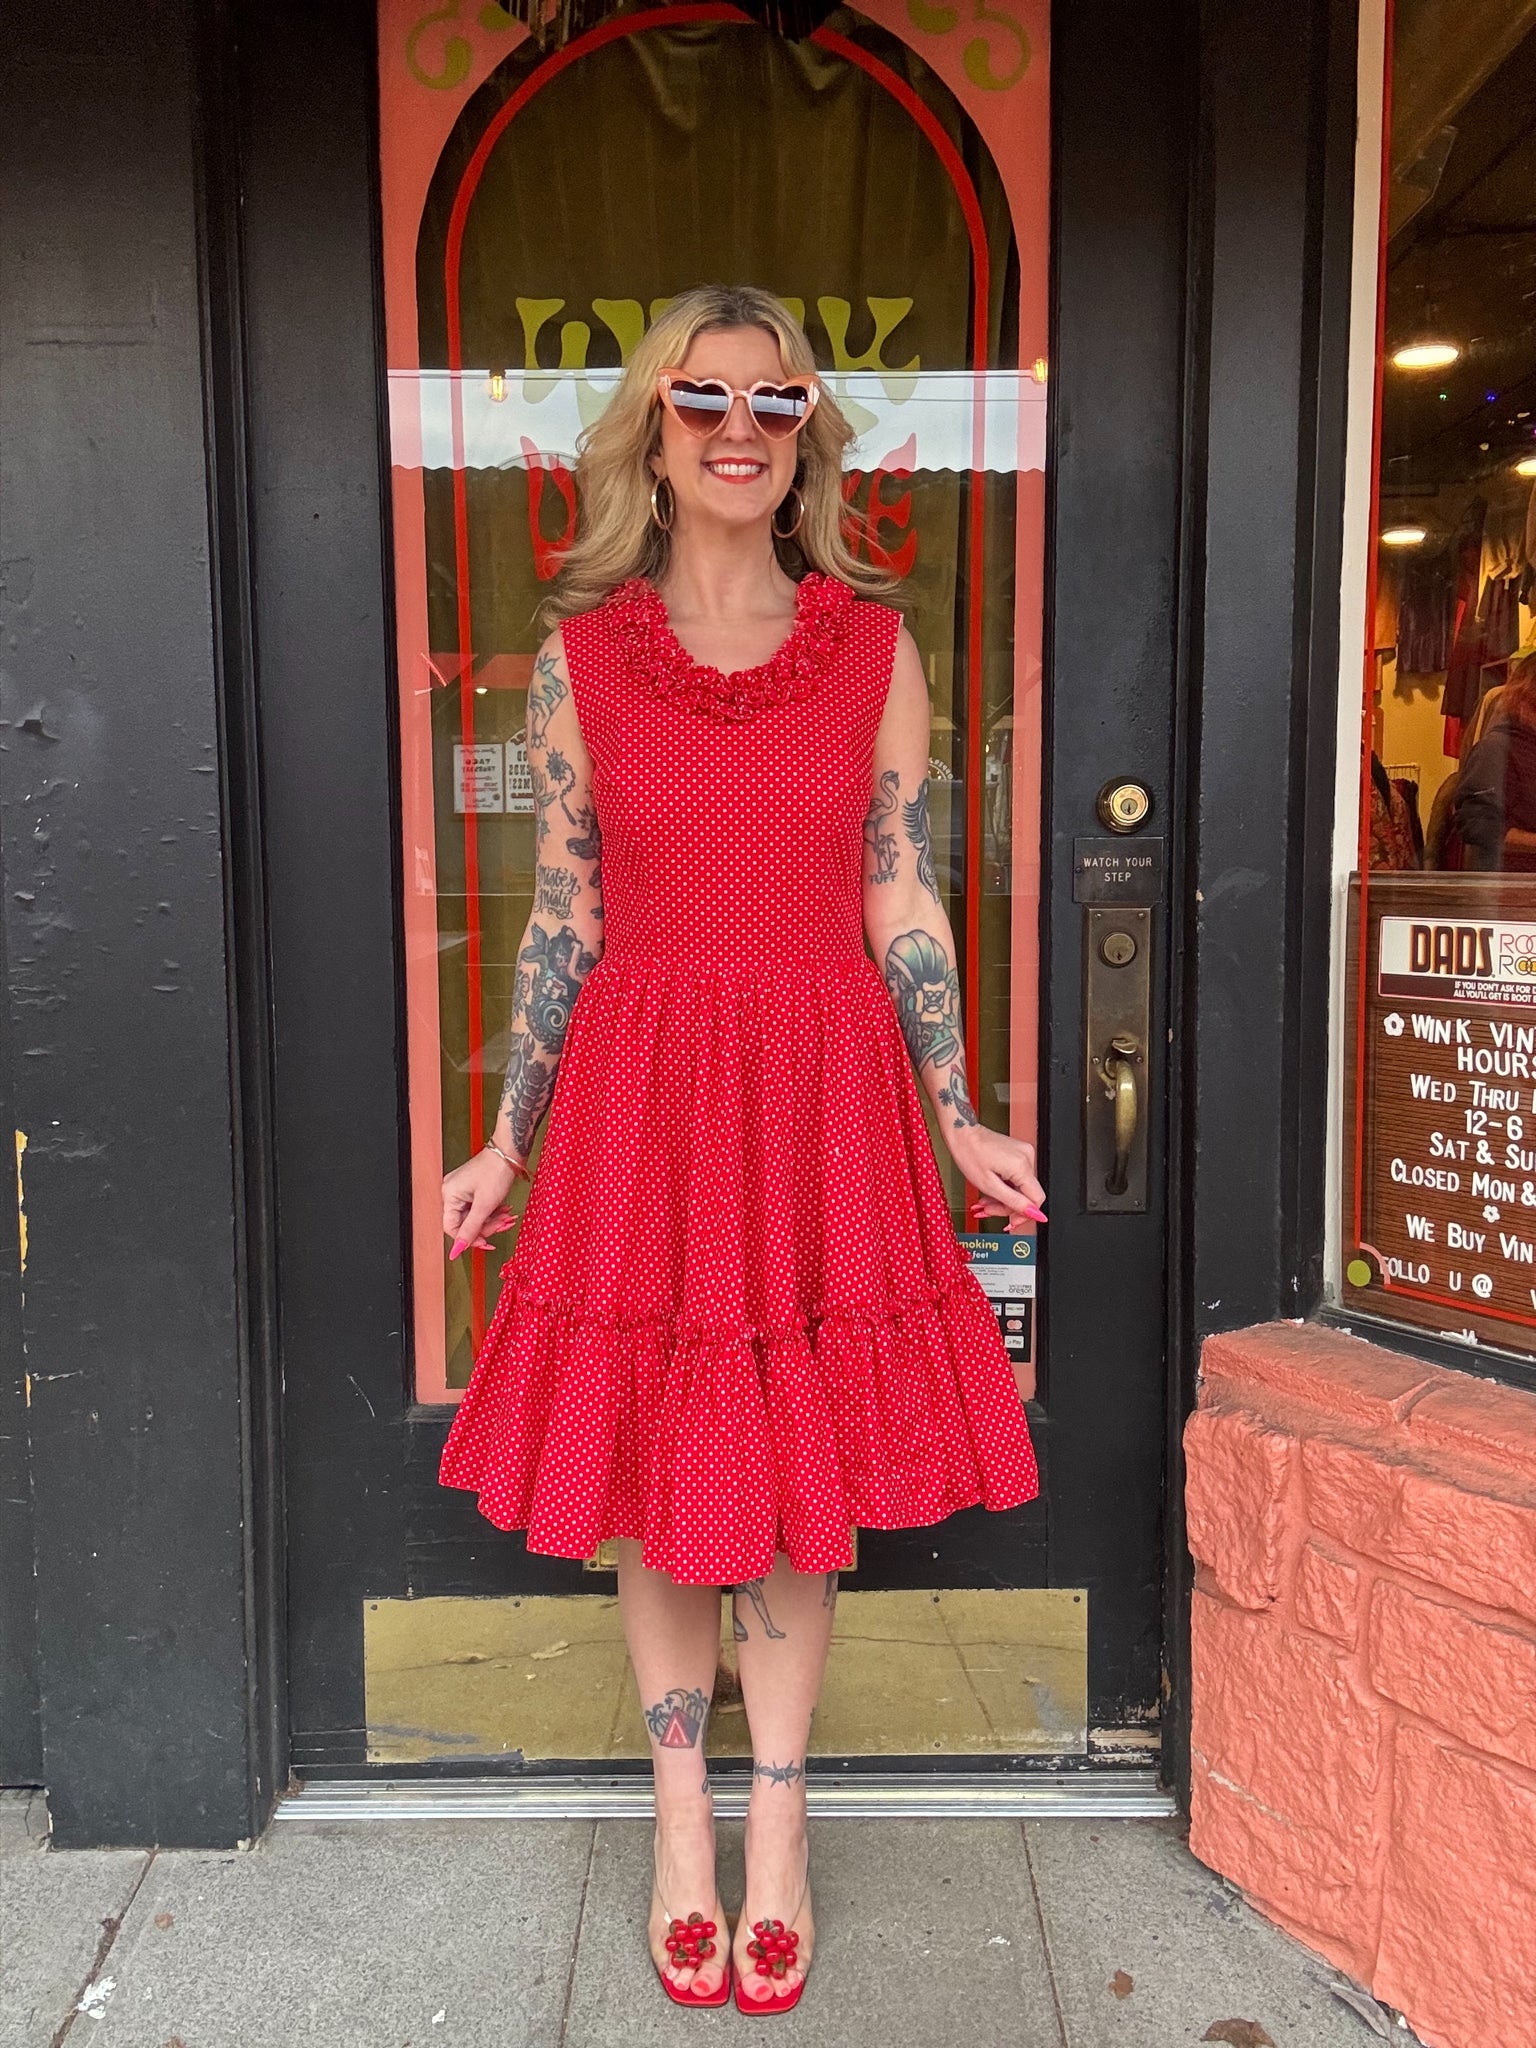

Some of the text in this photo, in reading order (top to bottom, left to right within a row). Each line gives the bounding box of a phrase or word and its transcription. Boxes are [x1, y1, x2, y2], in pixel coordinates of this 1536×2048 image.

[515, 296, 921, 437] WK
[1083, 856, 1153, 868] WATCH YOUR
[1104, 872, 1132, 882] STEP
[1453, 989, 1465, 998] ALL
[1466, 990, 1488, 999] YOU'LL
[1488, 992, 1502, 1001] GET
[1503, 993, 1510, 1001] IS
[1510, 993, 1532, 1003] ROOT
[1454, 981, 1461, 989] IF
[1462, 981, 1476, 990] YOU
[1477, 982, 1499, 992] DON'T
[1500, 984, 1515, 993] ASK
[1515, 985, 1531, 994] FOR
[1411, 1013, 1536, 1054] WINK VIN
[1464, 1109, 1523, 1140] 12-6
[1475, 1139, 1495, 1165] &
[1504, 1143, 1536, 1172] SU
[1520, 1180, 1536, 1206] &
[959, 1239, 999, 1252] moking
[1449, 1271, 1462, 1291] U
[1472, 1273, 1493, 1298] @
